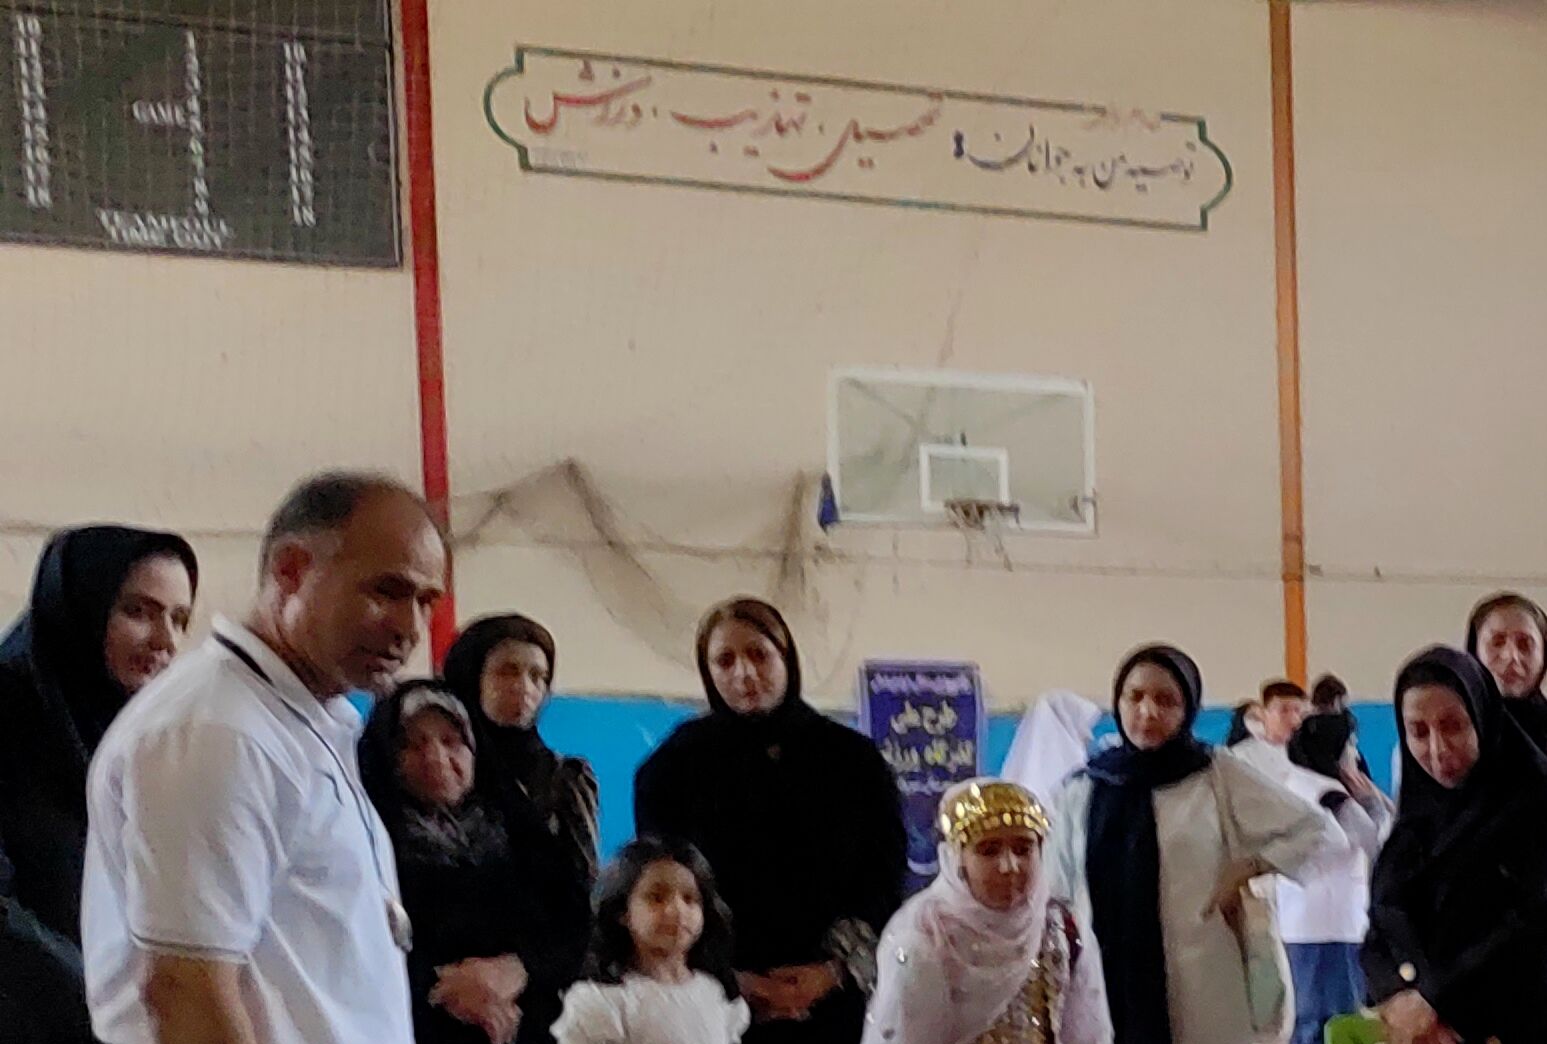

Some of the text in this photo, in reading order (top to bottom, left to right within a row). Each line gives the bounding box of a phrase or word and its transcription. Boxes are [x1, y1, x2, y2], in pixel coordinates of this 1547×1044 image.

[524, 59, 653, 133] ورزش
[670, 88, 812, 157] تهذیب
[1093, 154, 1126, 190] من
[1127, 141, 1196, 192] توصیه
